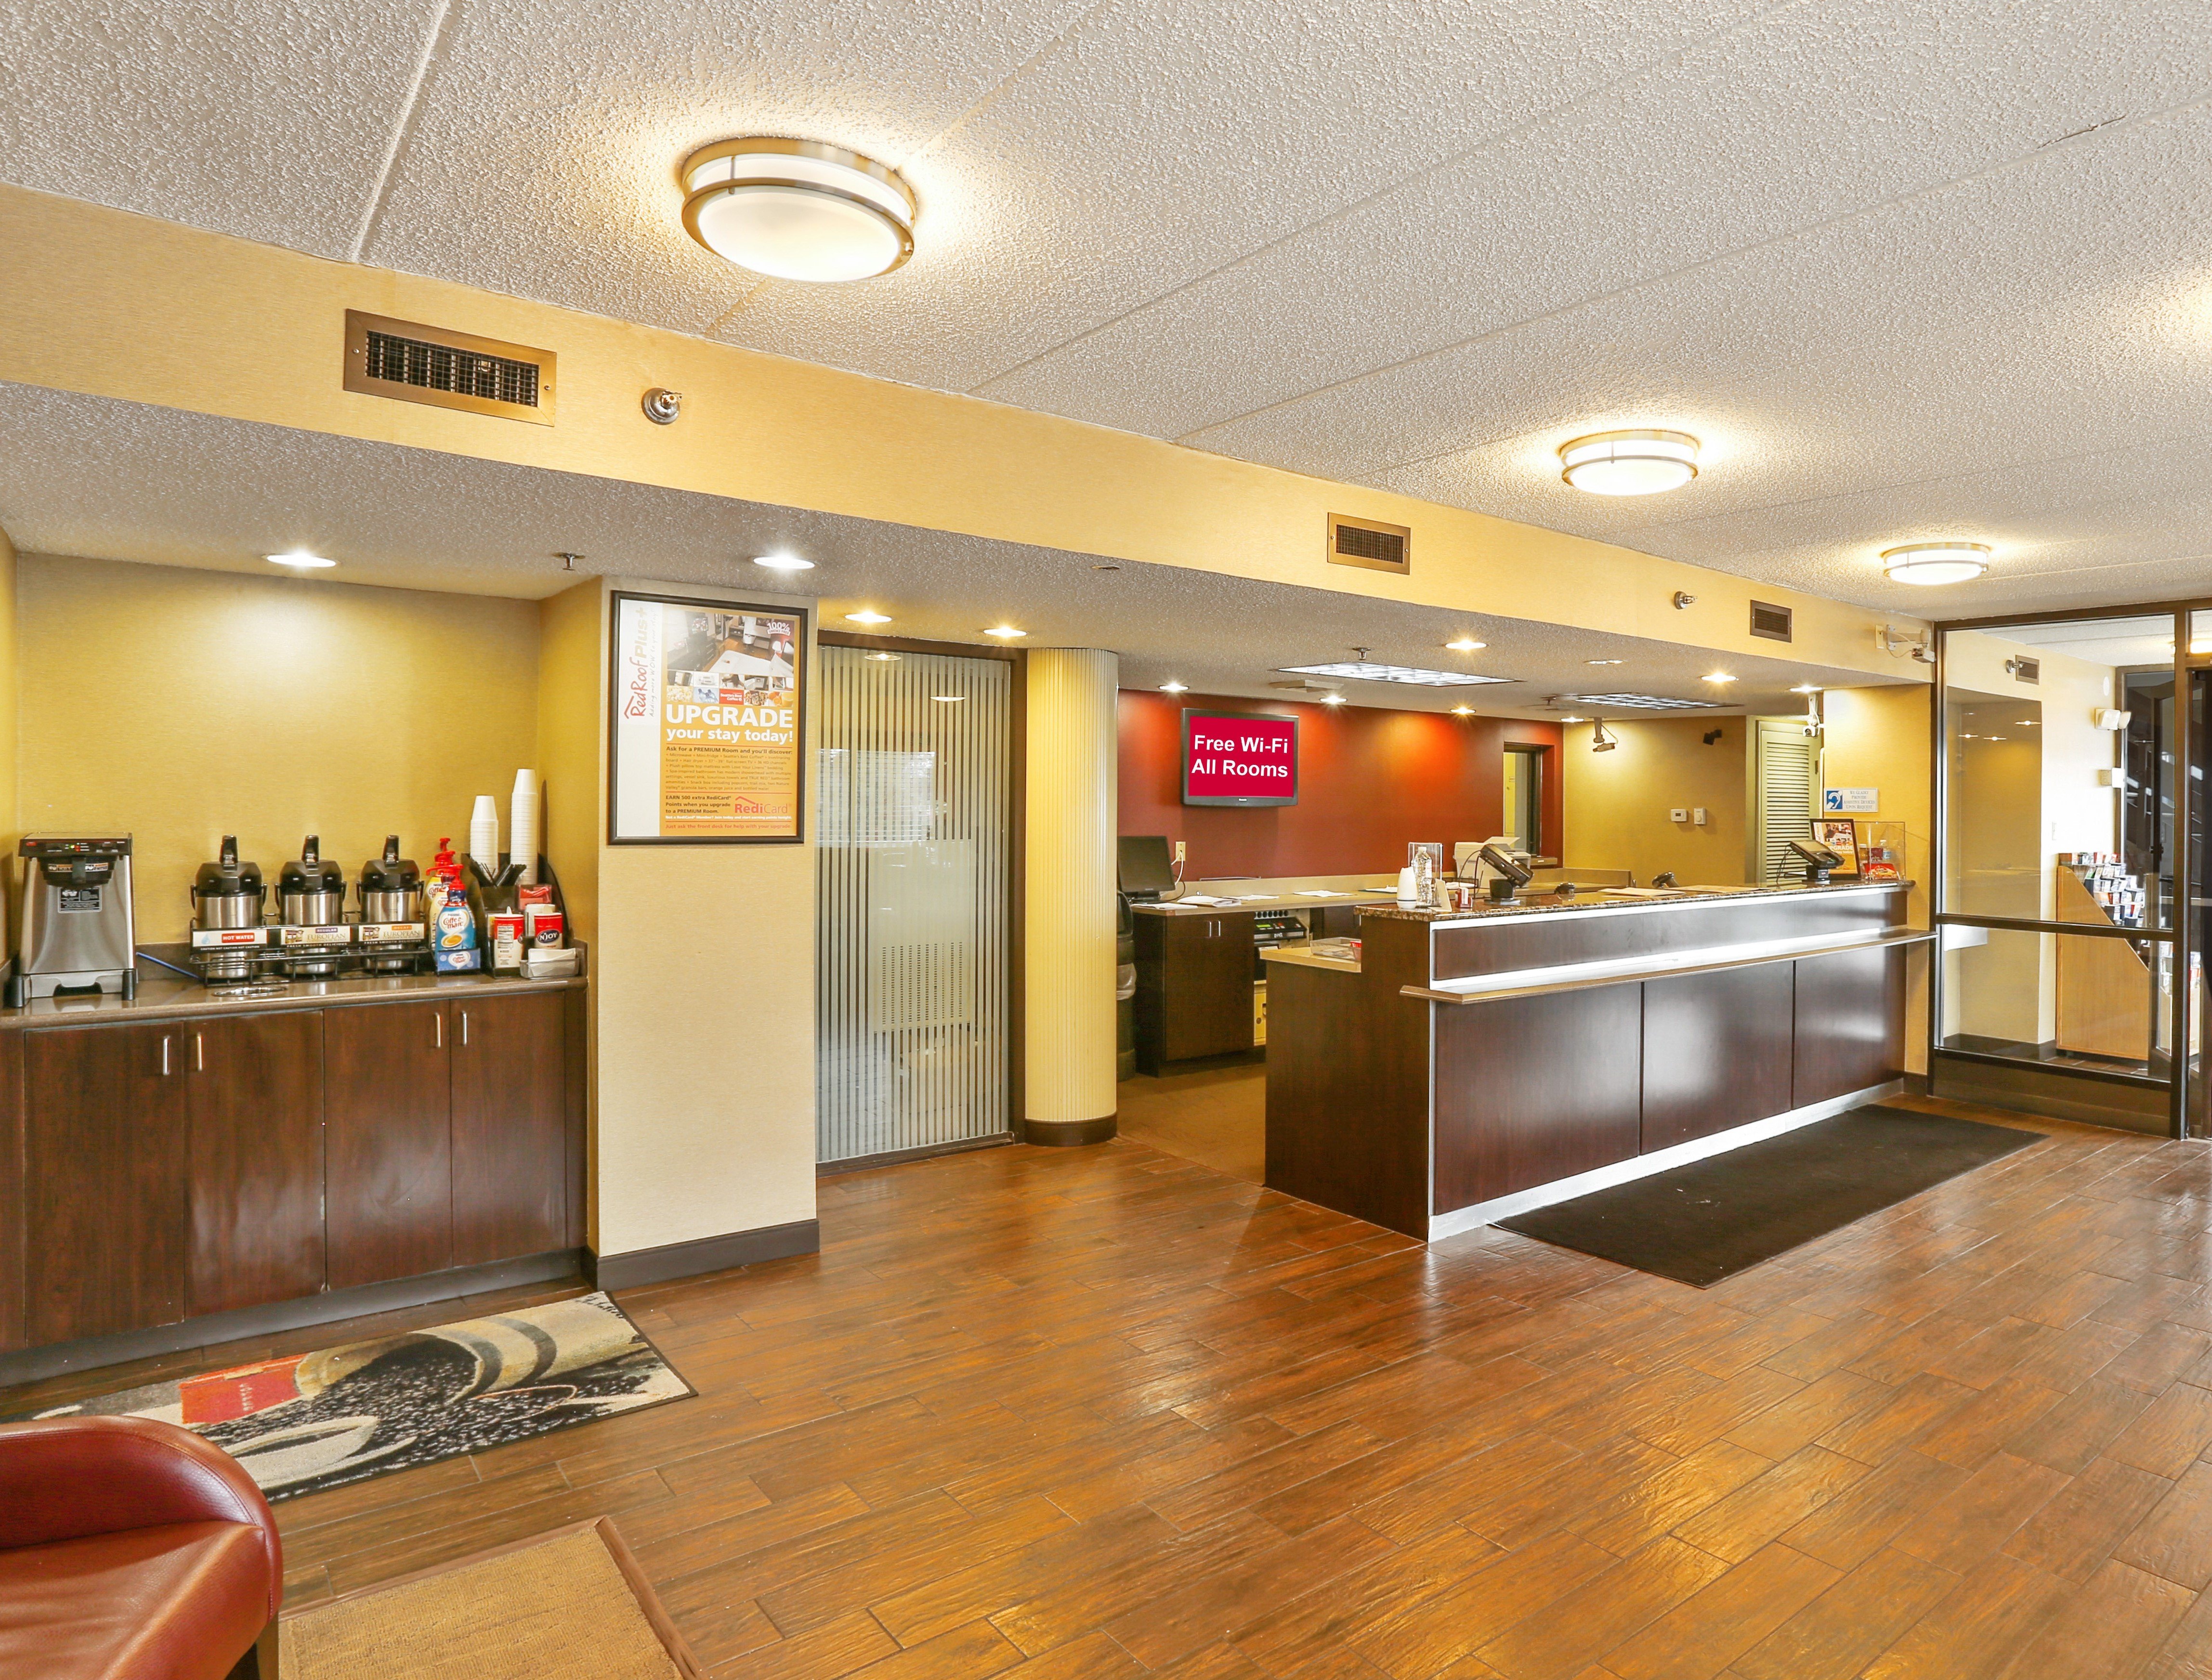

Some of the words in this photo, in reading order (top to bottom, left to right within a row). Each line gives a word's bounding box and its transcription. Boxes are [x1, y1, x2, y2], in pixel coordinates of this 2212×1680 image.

[767, 622, 790, 631] 100%
[666, 704, 793, 728] UPGRADE
[666, 728, 704, 741] your
[708, 728, 740, 743] stay
[745, 729, 793, 745] today!
[1194, 735, 1235, 751] Free
[1241, 736, 1288, 754] Wi-Fi
[1191, 759, 1216, 774] All
[1223, 760, 1288, 777] Rooms
